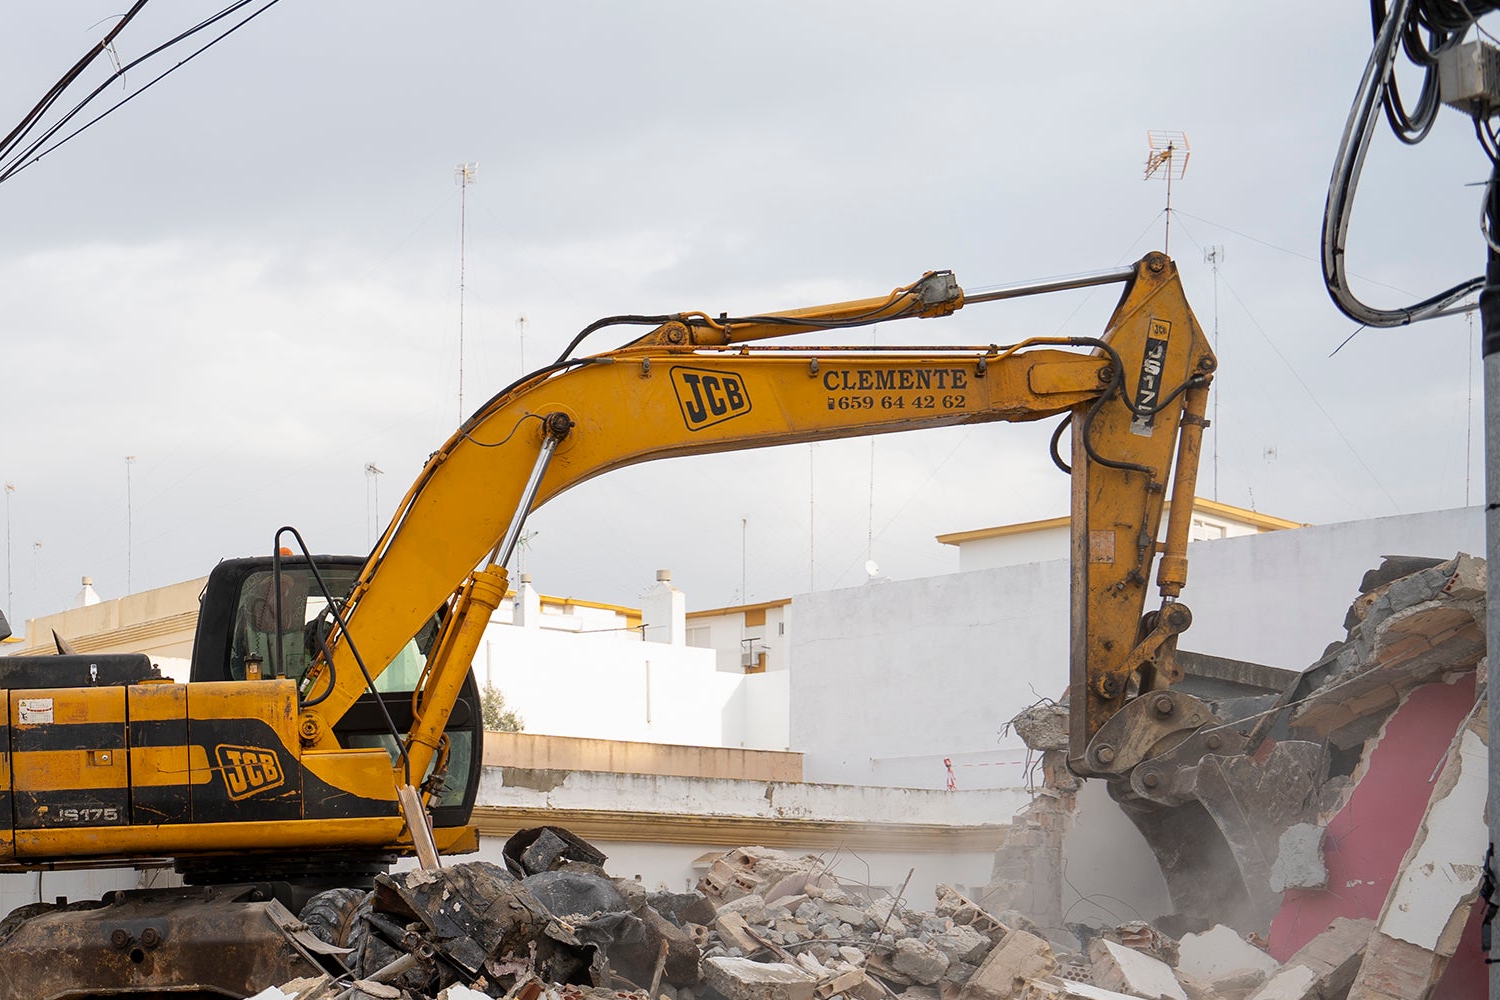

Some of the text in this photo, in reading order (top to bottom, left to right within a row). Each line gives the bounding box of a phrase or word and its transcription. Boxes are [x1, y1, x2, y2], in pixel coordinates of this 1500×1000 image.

[823, 368, 968, 391] CLEMENTE
[683, 373, 745, 423] JCB
[838, 395, 966, 410] 659 64 42 62
[226, 750, 279, 793] JCB
[52, 808, 118, 822] JS175
